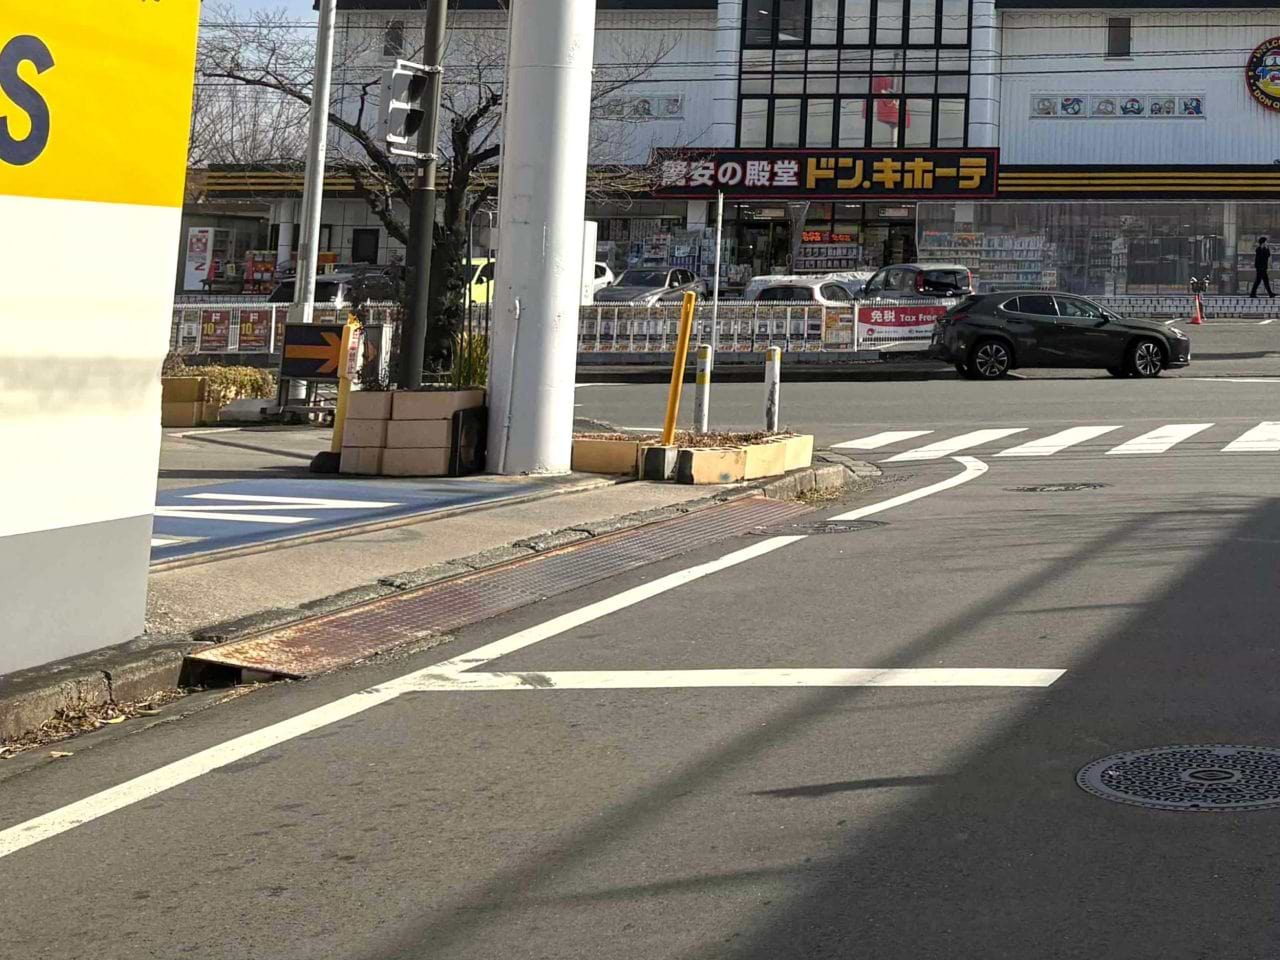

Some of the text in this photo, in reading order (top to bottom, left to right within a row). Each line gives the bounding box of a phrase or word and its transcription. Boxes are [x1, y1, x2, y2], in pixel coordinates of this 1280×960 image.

[1254, 89, 1273, 106] DON
[661, 159, 800, 187] 驚安の殿堂
[870, 310, 896, 323] 免税
[899, 313, 916, 323] Tax
